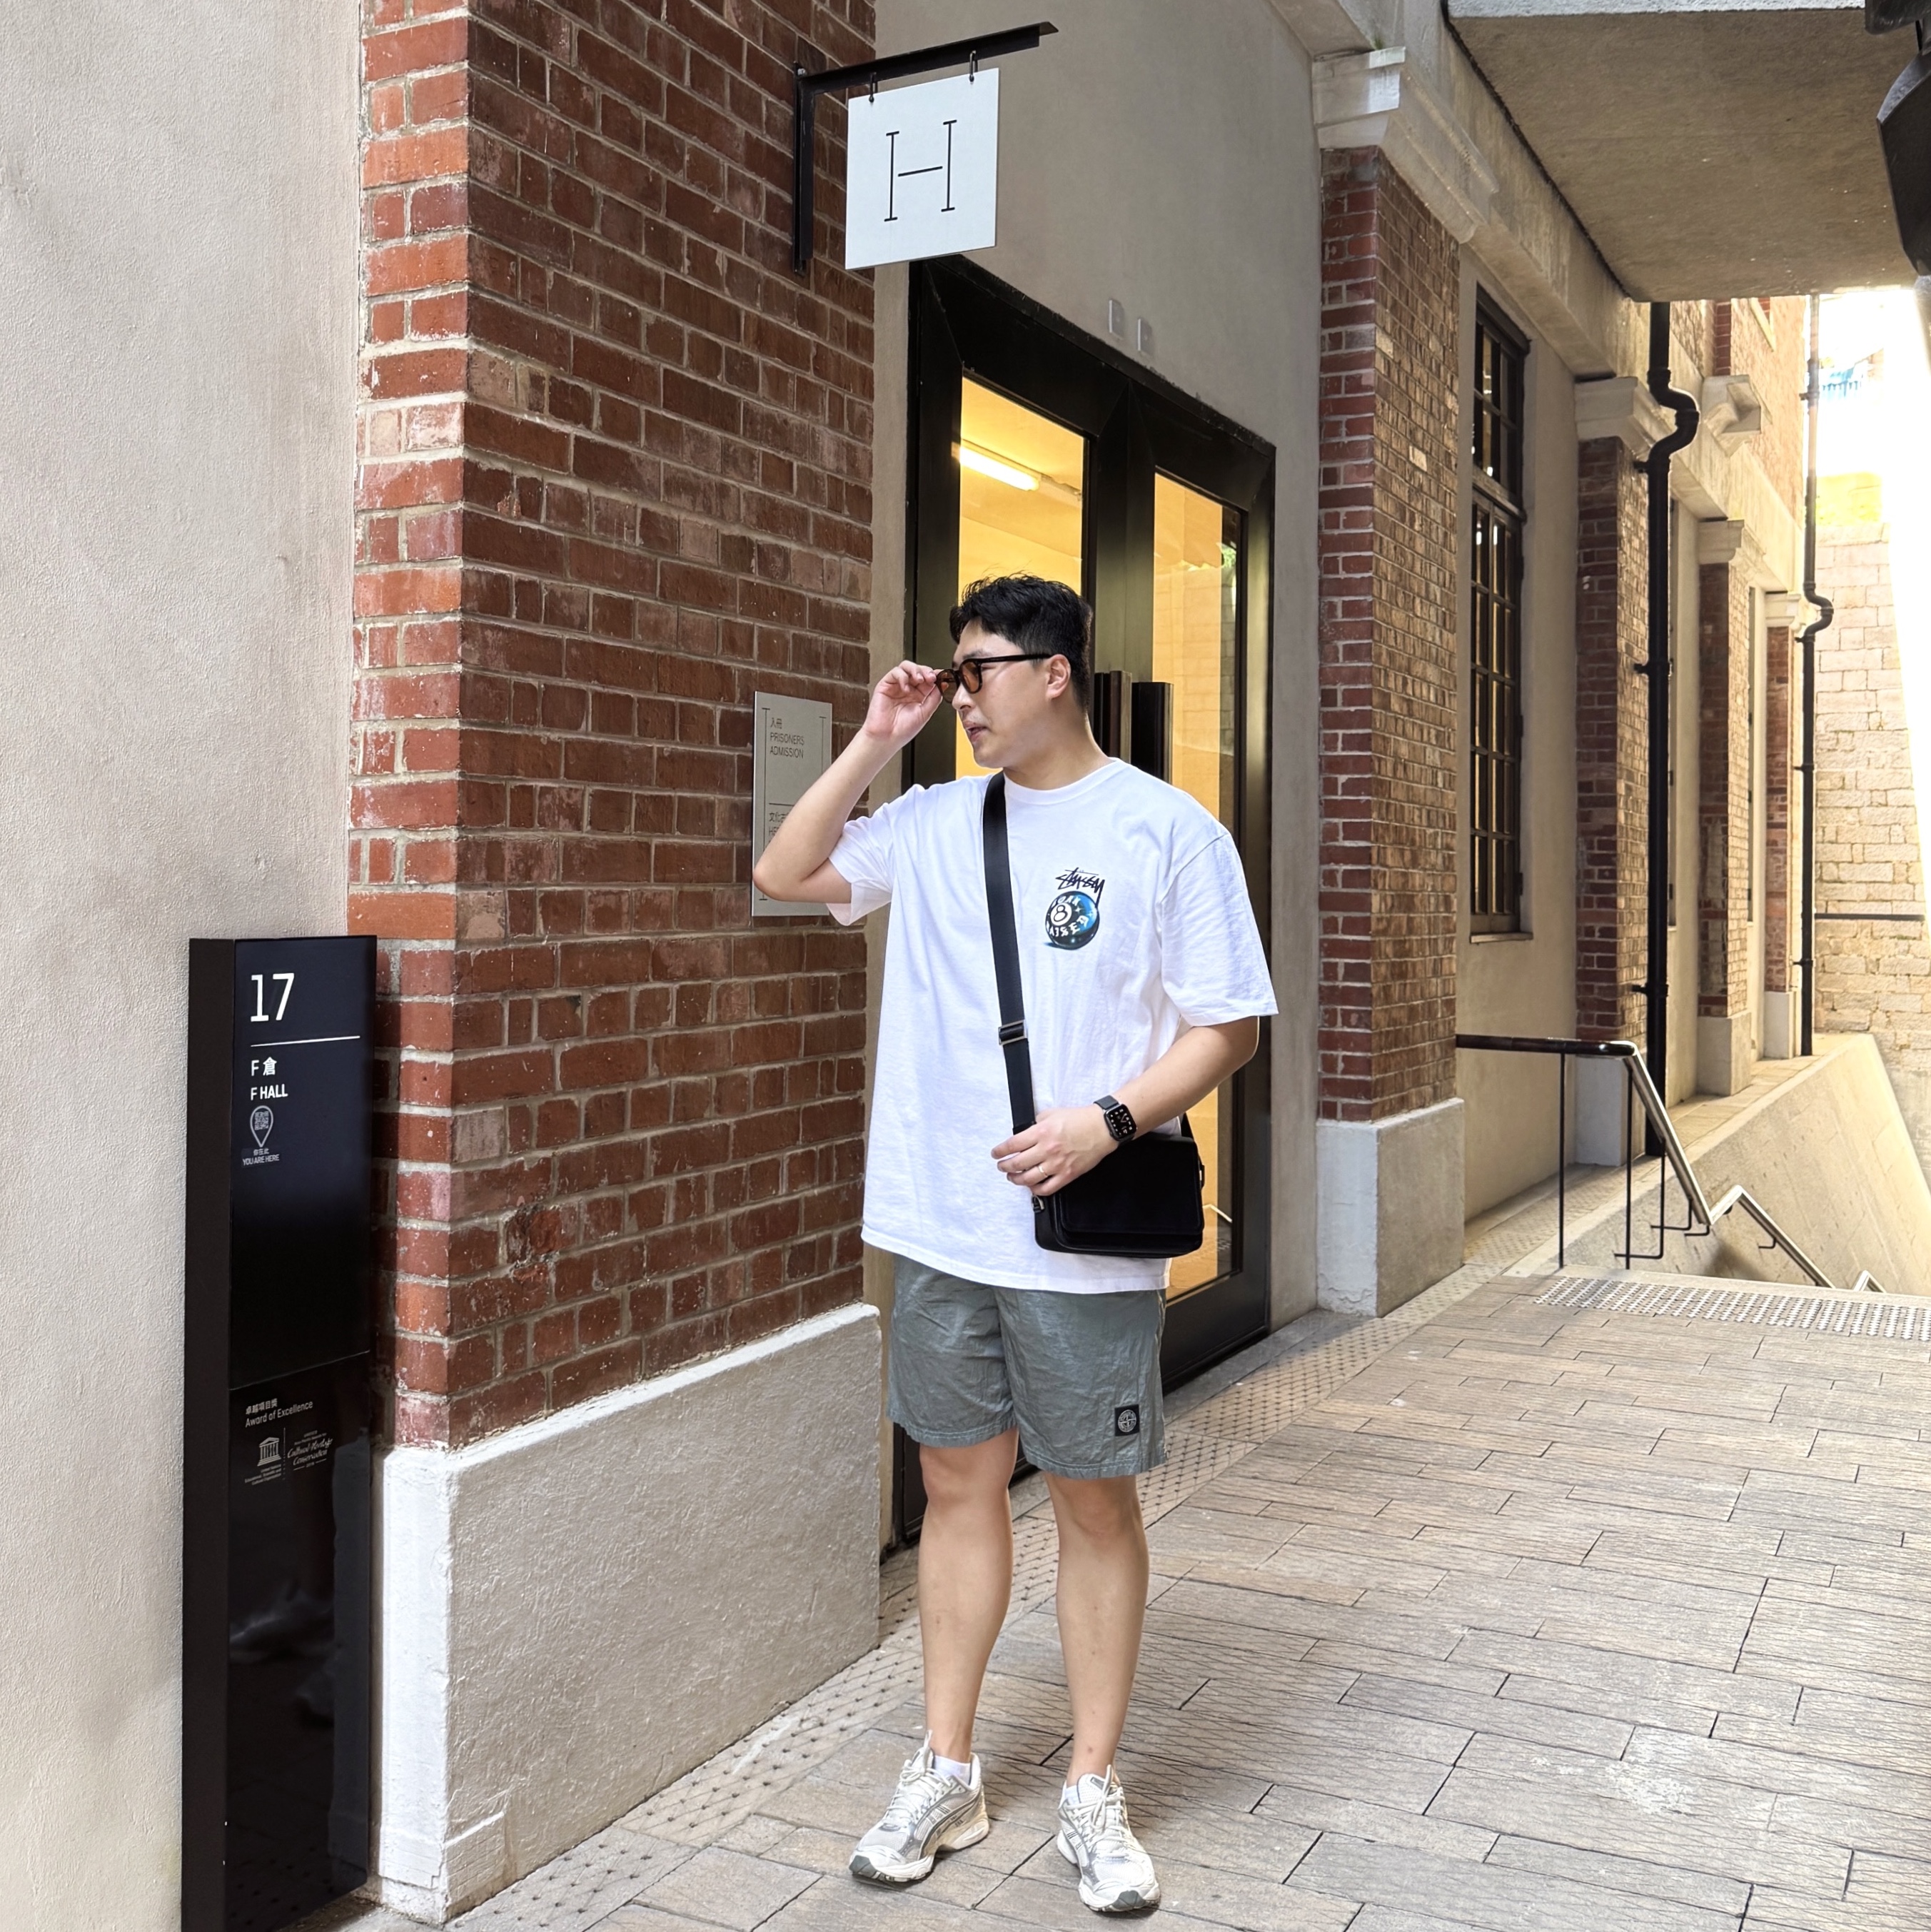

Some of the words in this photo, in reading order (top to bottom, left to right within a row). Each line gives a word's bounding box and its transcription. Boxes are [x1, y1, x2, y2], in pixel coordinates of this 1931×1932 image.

[884, 119, 957, 222] H
[770, 732, 805, 745] PRISONERS
[770, 745, 804, 759] ADMISSION
[1053, 904, 1068, 922] 8
[251, 972, 295, 1022] 17
[251, 1060, 260, 1077] F
[250, 1087, 258, 1101] F
[260, 1084, 288, 1100] HALL
[243, 1157, 254, 1166] YOU
[265, 1154, 280, 1162] HERE
[245, 1413, 267, 1428] Award
[268, 1409, 276, 1421] of
[277, 1401, 313, 1419] Excellence
